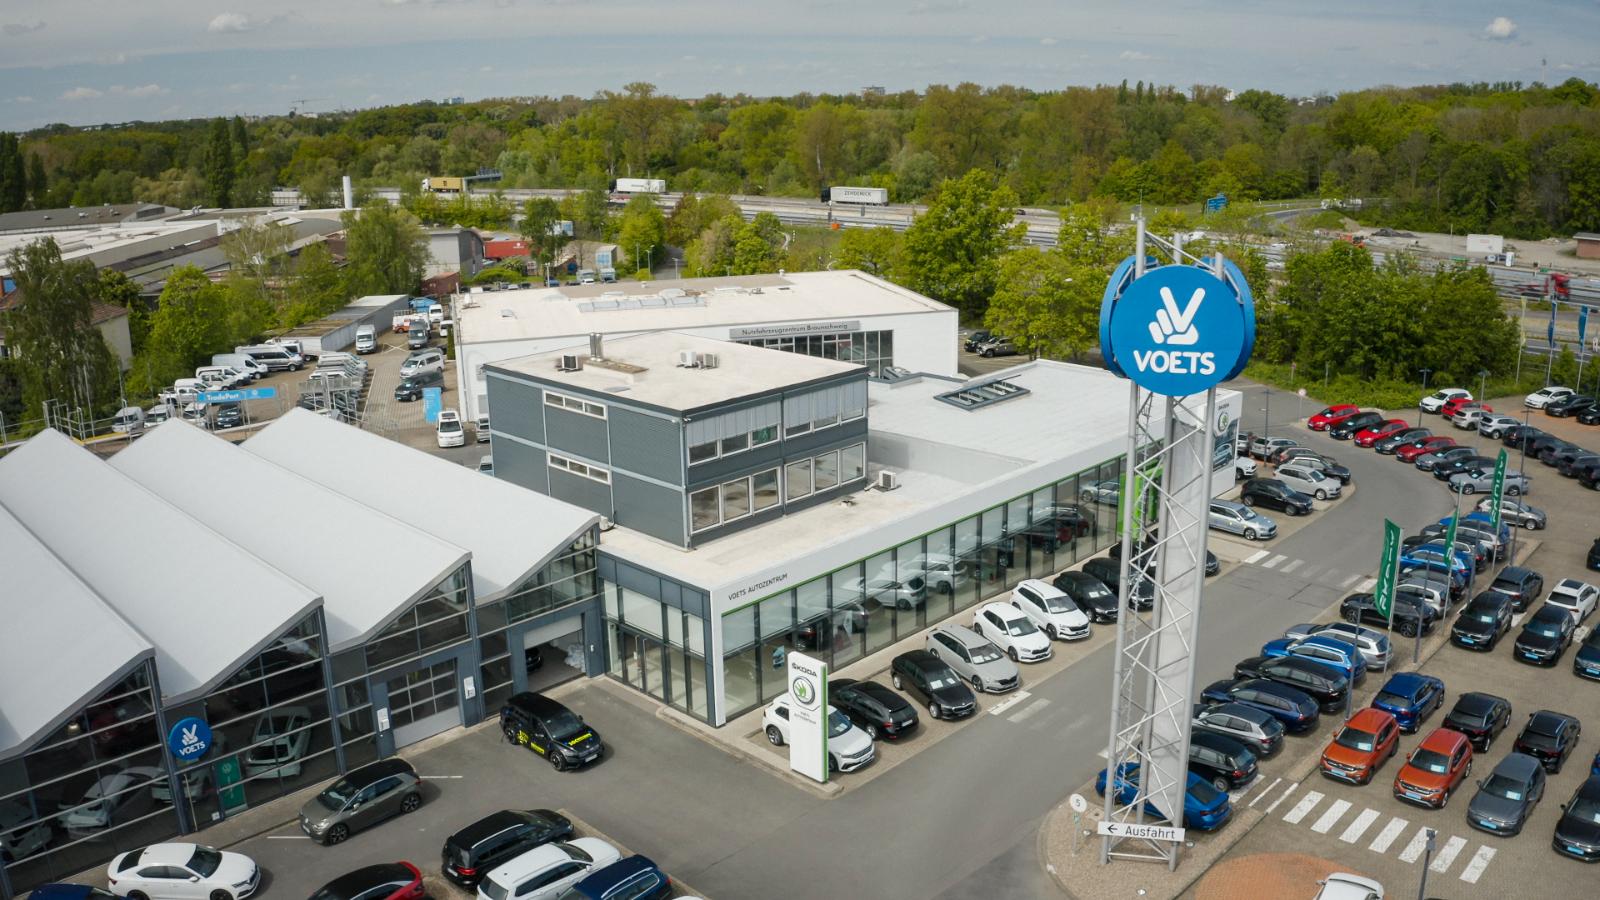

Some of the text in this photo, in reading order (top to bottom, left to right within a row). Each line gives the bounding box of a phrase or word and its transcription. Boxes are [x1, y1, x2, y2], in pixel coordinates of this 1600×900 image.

[1133, 350, 1216, 375] VOETS
[728, 573, 788, 600] VOETS AUTOZENTRUM
[178, 740, 206, 756] VOETS
[1125, 825, 1175, 839] Ausfahrt
